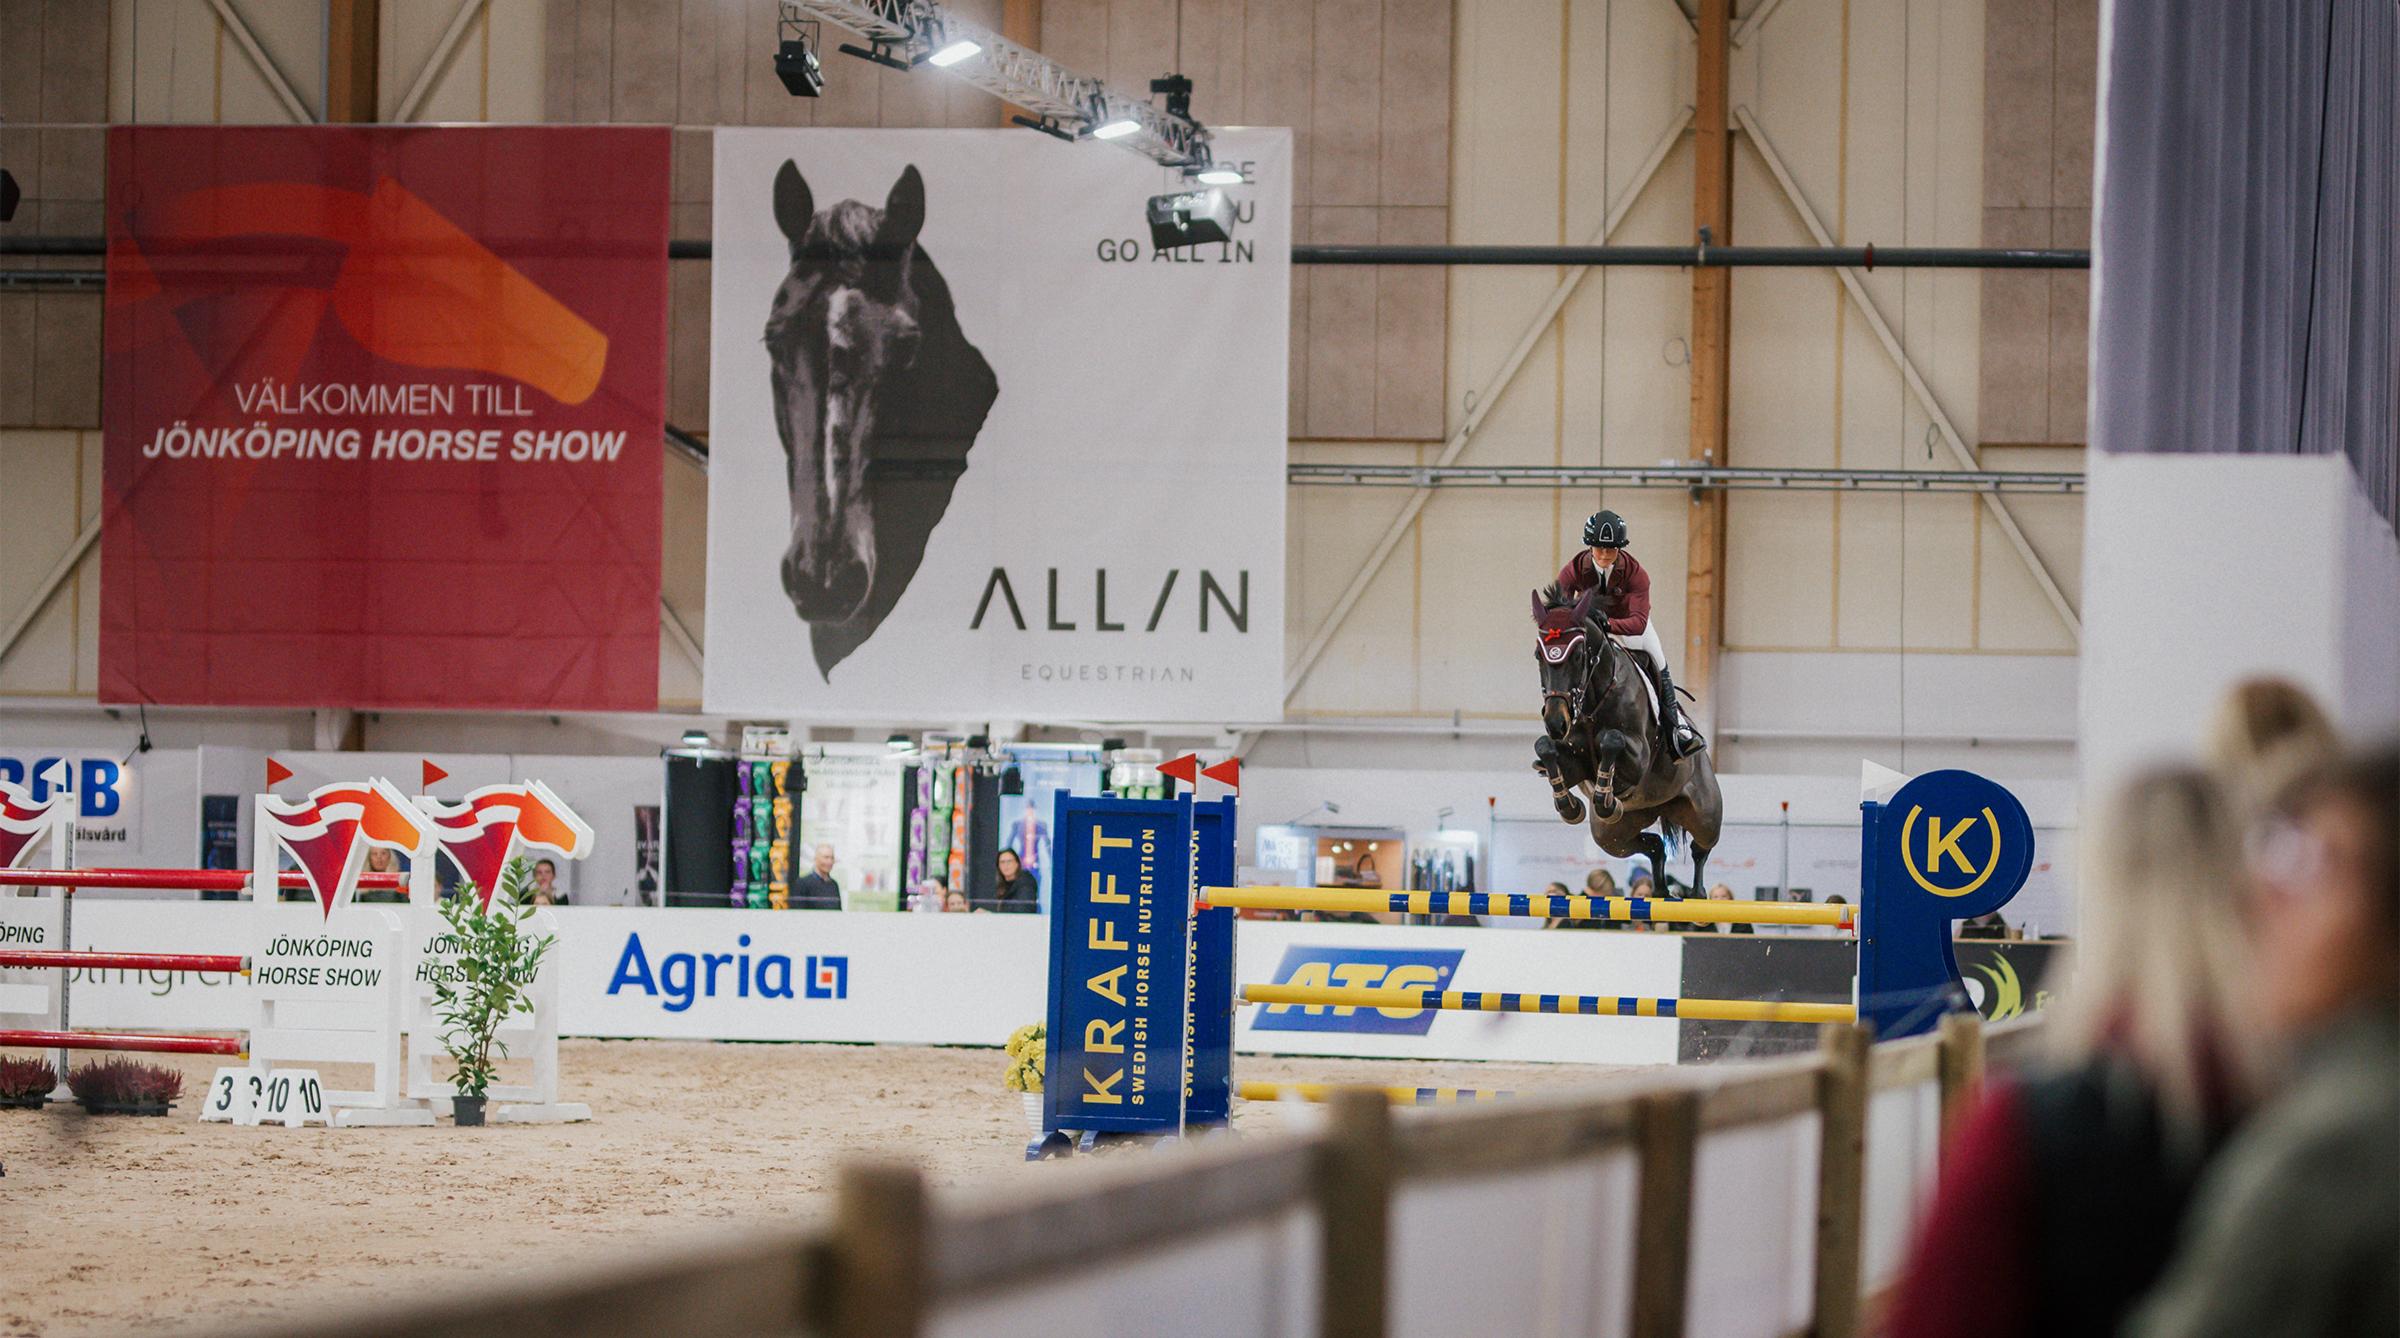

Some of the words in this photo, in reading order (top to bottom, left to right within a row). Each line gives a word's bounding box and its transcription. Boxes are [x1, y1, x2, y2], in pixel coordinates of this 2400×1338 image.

[1097, 238, 1140, 263] GO
[1218, 239, 1254, 263] IN
[233, 376, 454, 416] VÄLKOMMEN
[463, 383, 534, 417] TILL
[142, 420, 361, 461] JÖNKÖPING
[371, 428, 502, 462] HORSE
[509, 429, 627, 463] SHOW
[1021, 662, 1194, 682] EQUESTRIAN
[1926, 816, 1979, 874] K
[1138, 828, 1156, 934] NUTRITION
[265, 933, 374, 958] JÖNKÖPING
[1082, 824, 1134, 1105] KRAFFT
[257, 966, 321, 986] HORSE
[325, 968, 382, 987] SHOW
[415, 964, 472, 983] HORS
[606, 931, 795, 1013] Agria
[1135, 943, 1151, 1007] HORSE
[1265, 962, 1440, 1020] ATG
[1131, 1017, 1148, 1106] SWEDISH
[215, 1075, 234, 1111] 3
[267, 1077, 290, 1113] 10
[299, 1077, 322, 1114] 10
